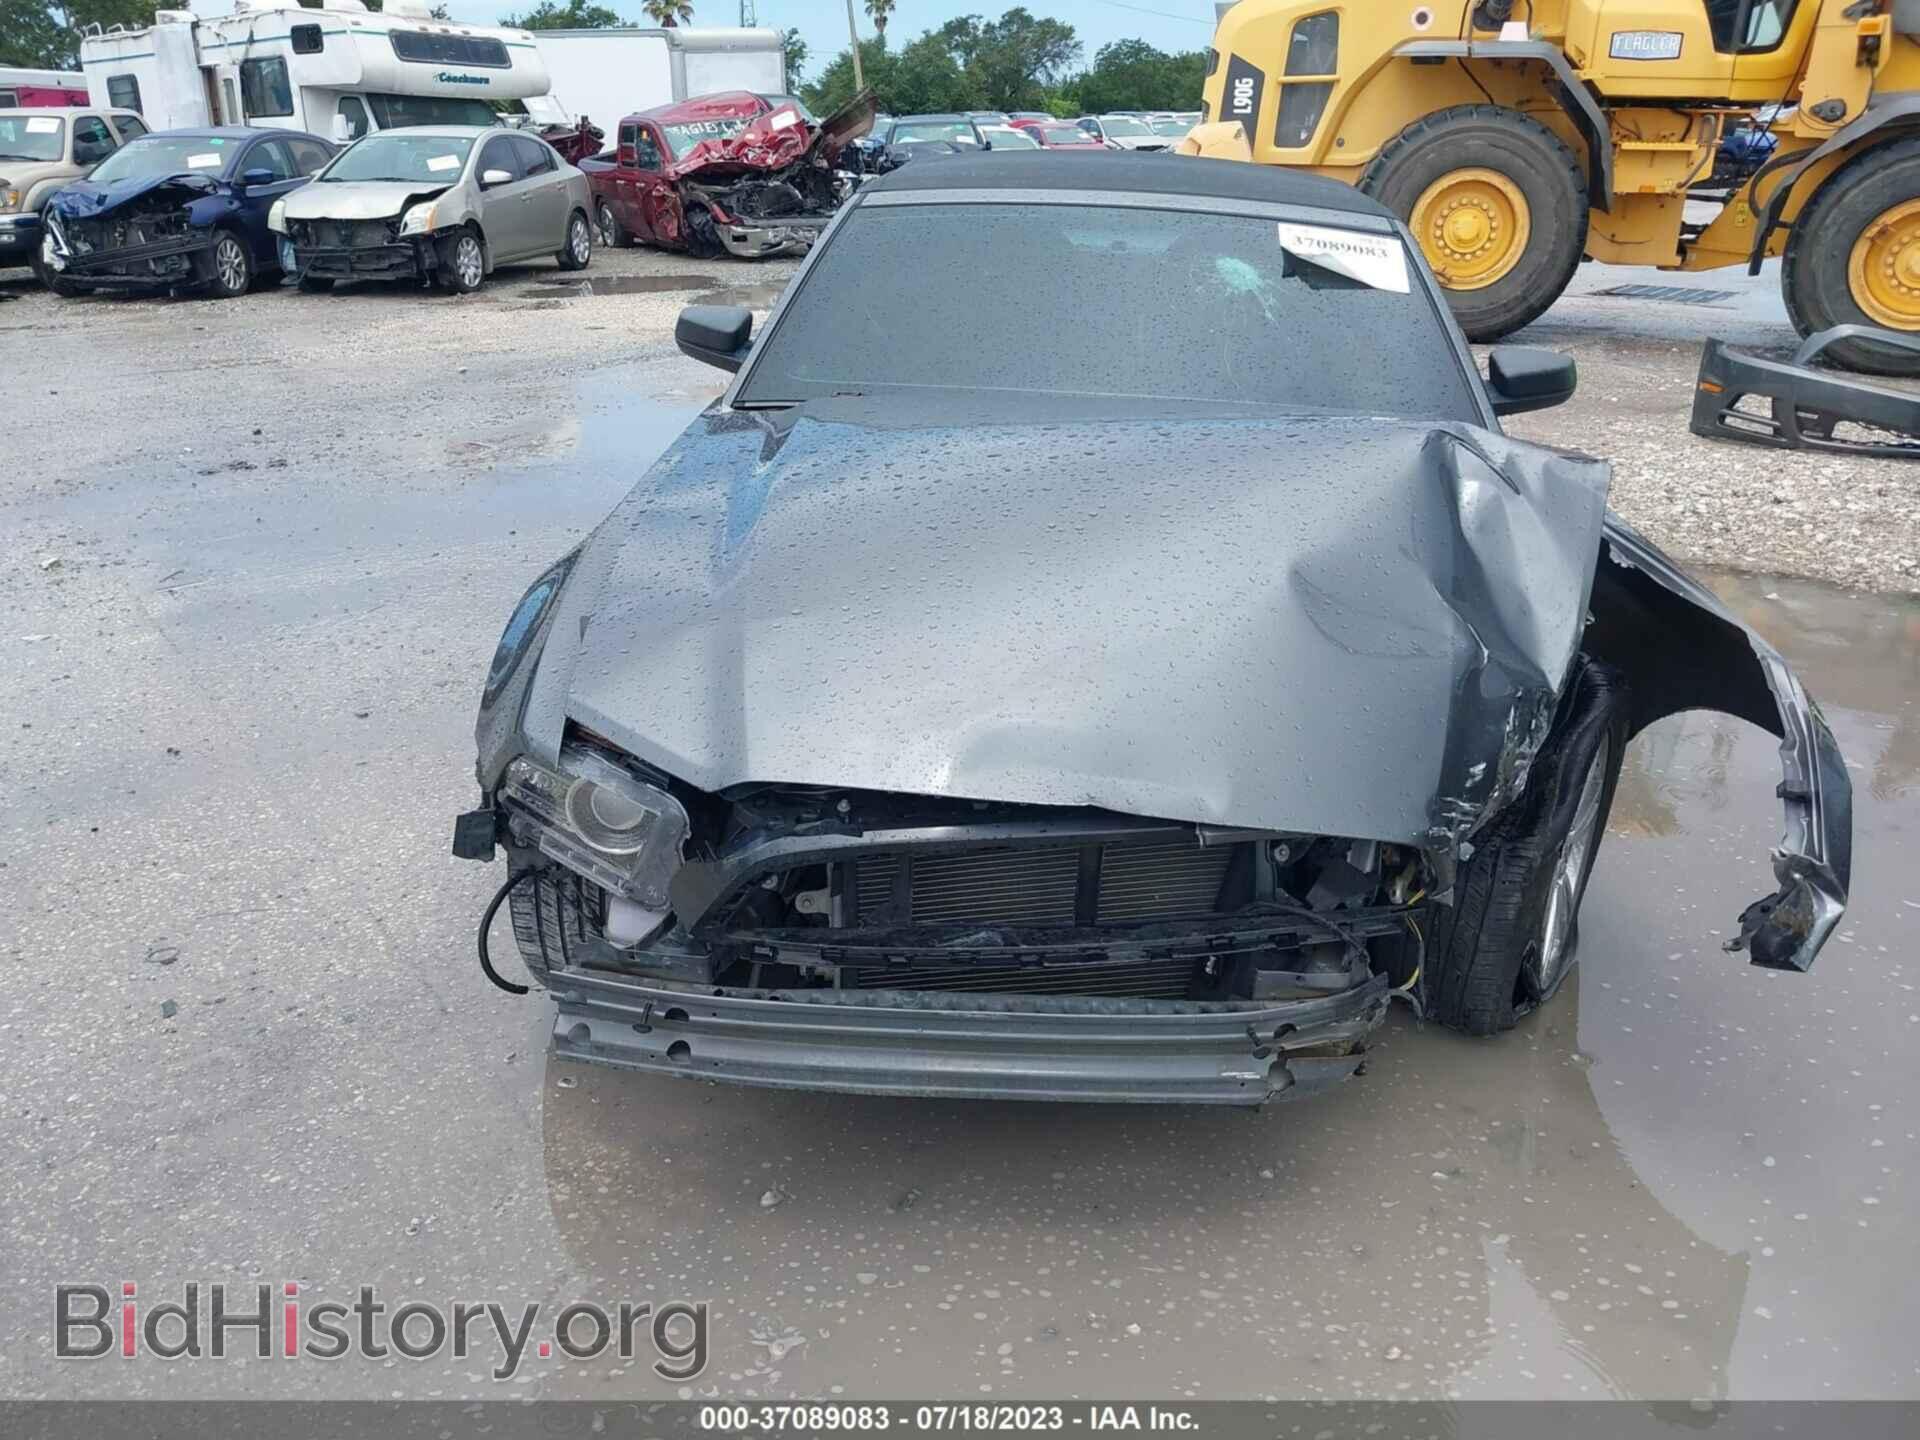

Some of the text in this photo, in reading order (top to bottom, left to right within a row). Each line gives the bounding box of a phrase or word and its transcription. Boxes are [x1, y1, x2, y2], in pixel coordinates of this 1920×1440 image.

[1616, 34, 1680, 51] FLAGLER
[1233, 78, 1254, 114] L90G
[1294, 234, 1390, 258] 37089083
